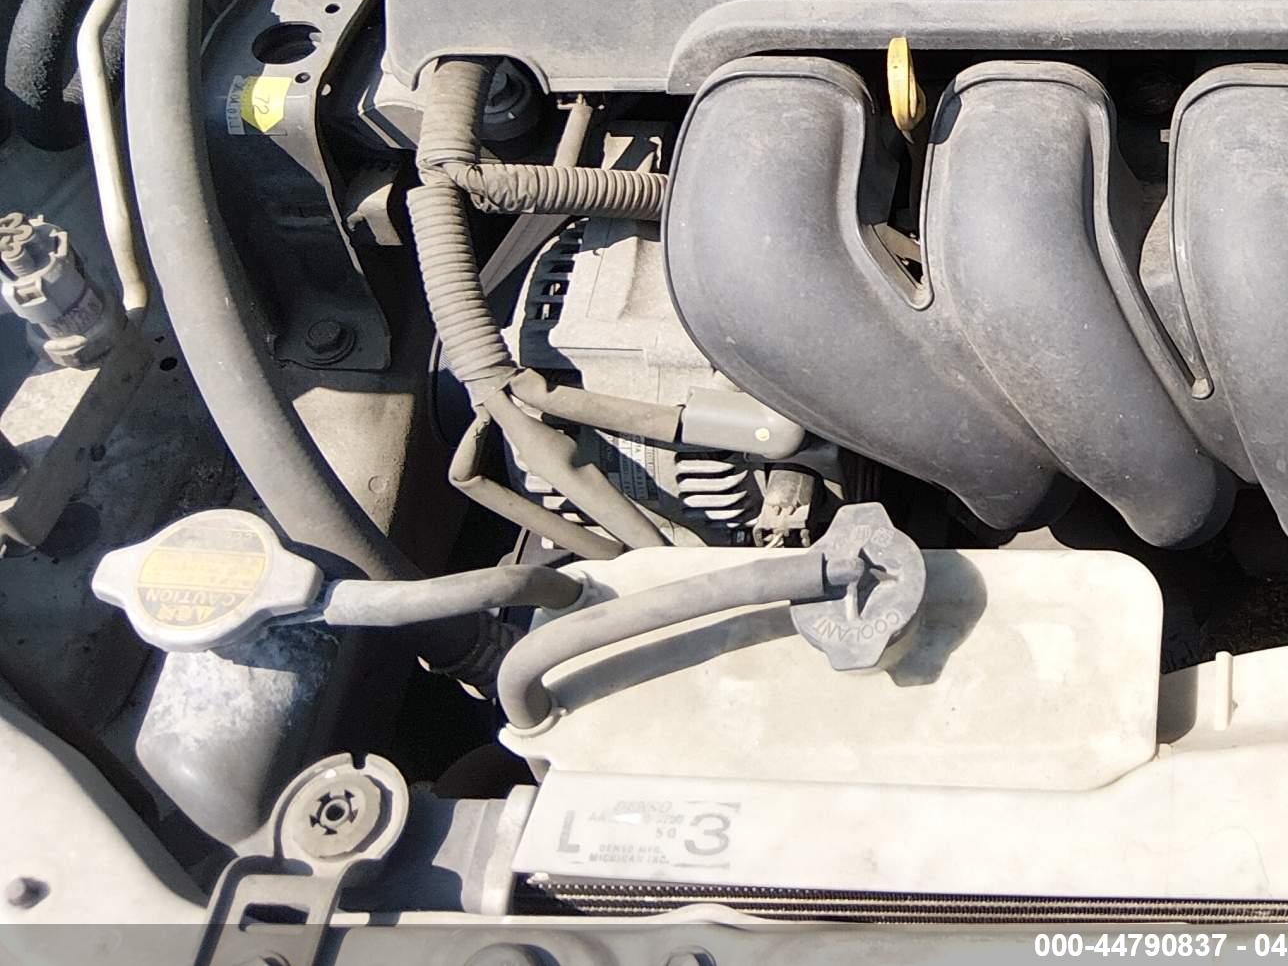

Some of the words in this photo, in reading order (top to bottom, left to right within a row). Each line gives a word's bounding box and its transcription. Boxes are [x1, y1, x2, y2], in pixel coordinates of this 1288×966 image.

[145, 587, 236, 606] CAUTION
[814, 609, 901, 643] COOLANT
[556, 809, 582, 854] L
[683, 812, 732, 857] 3
